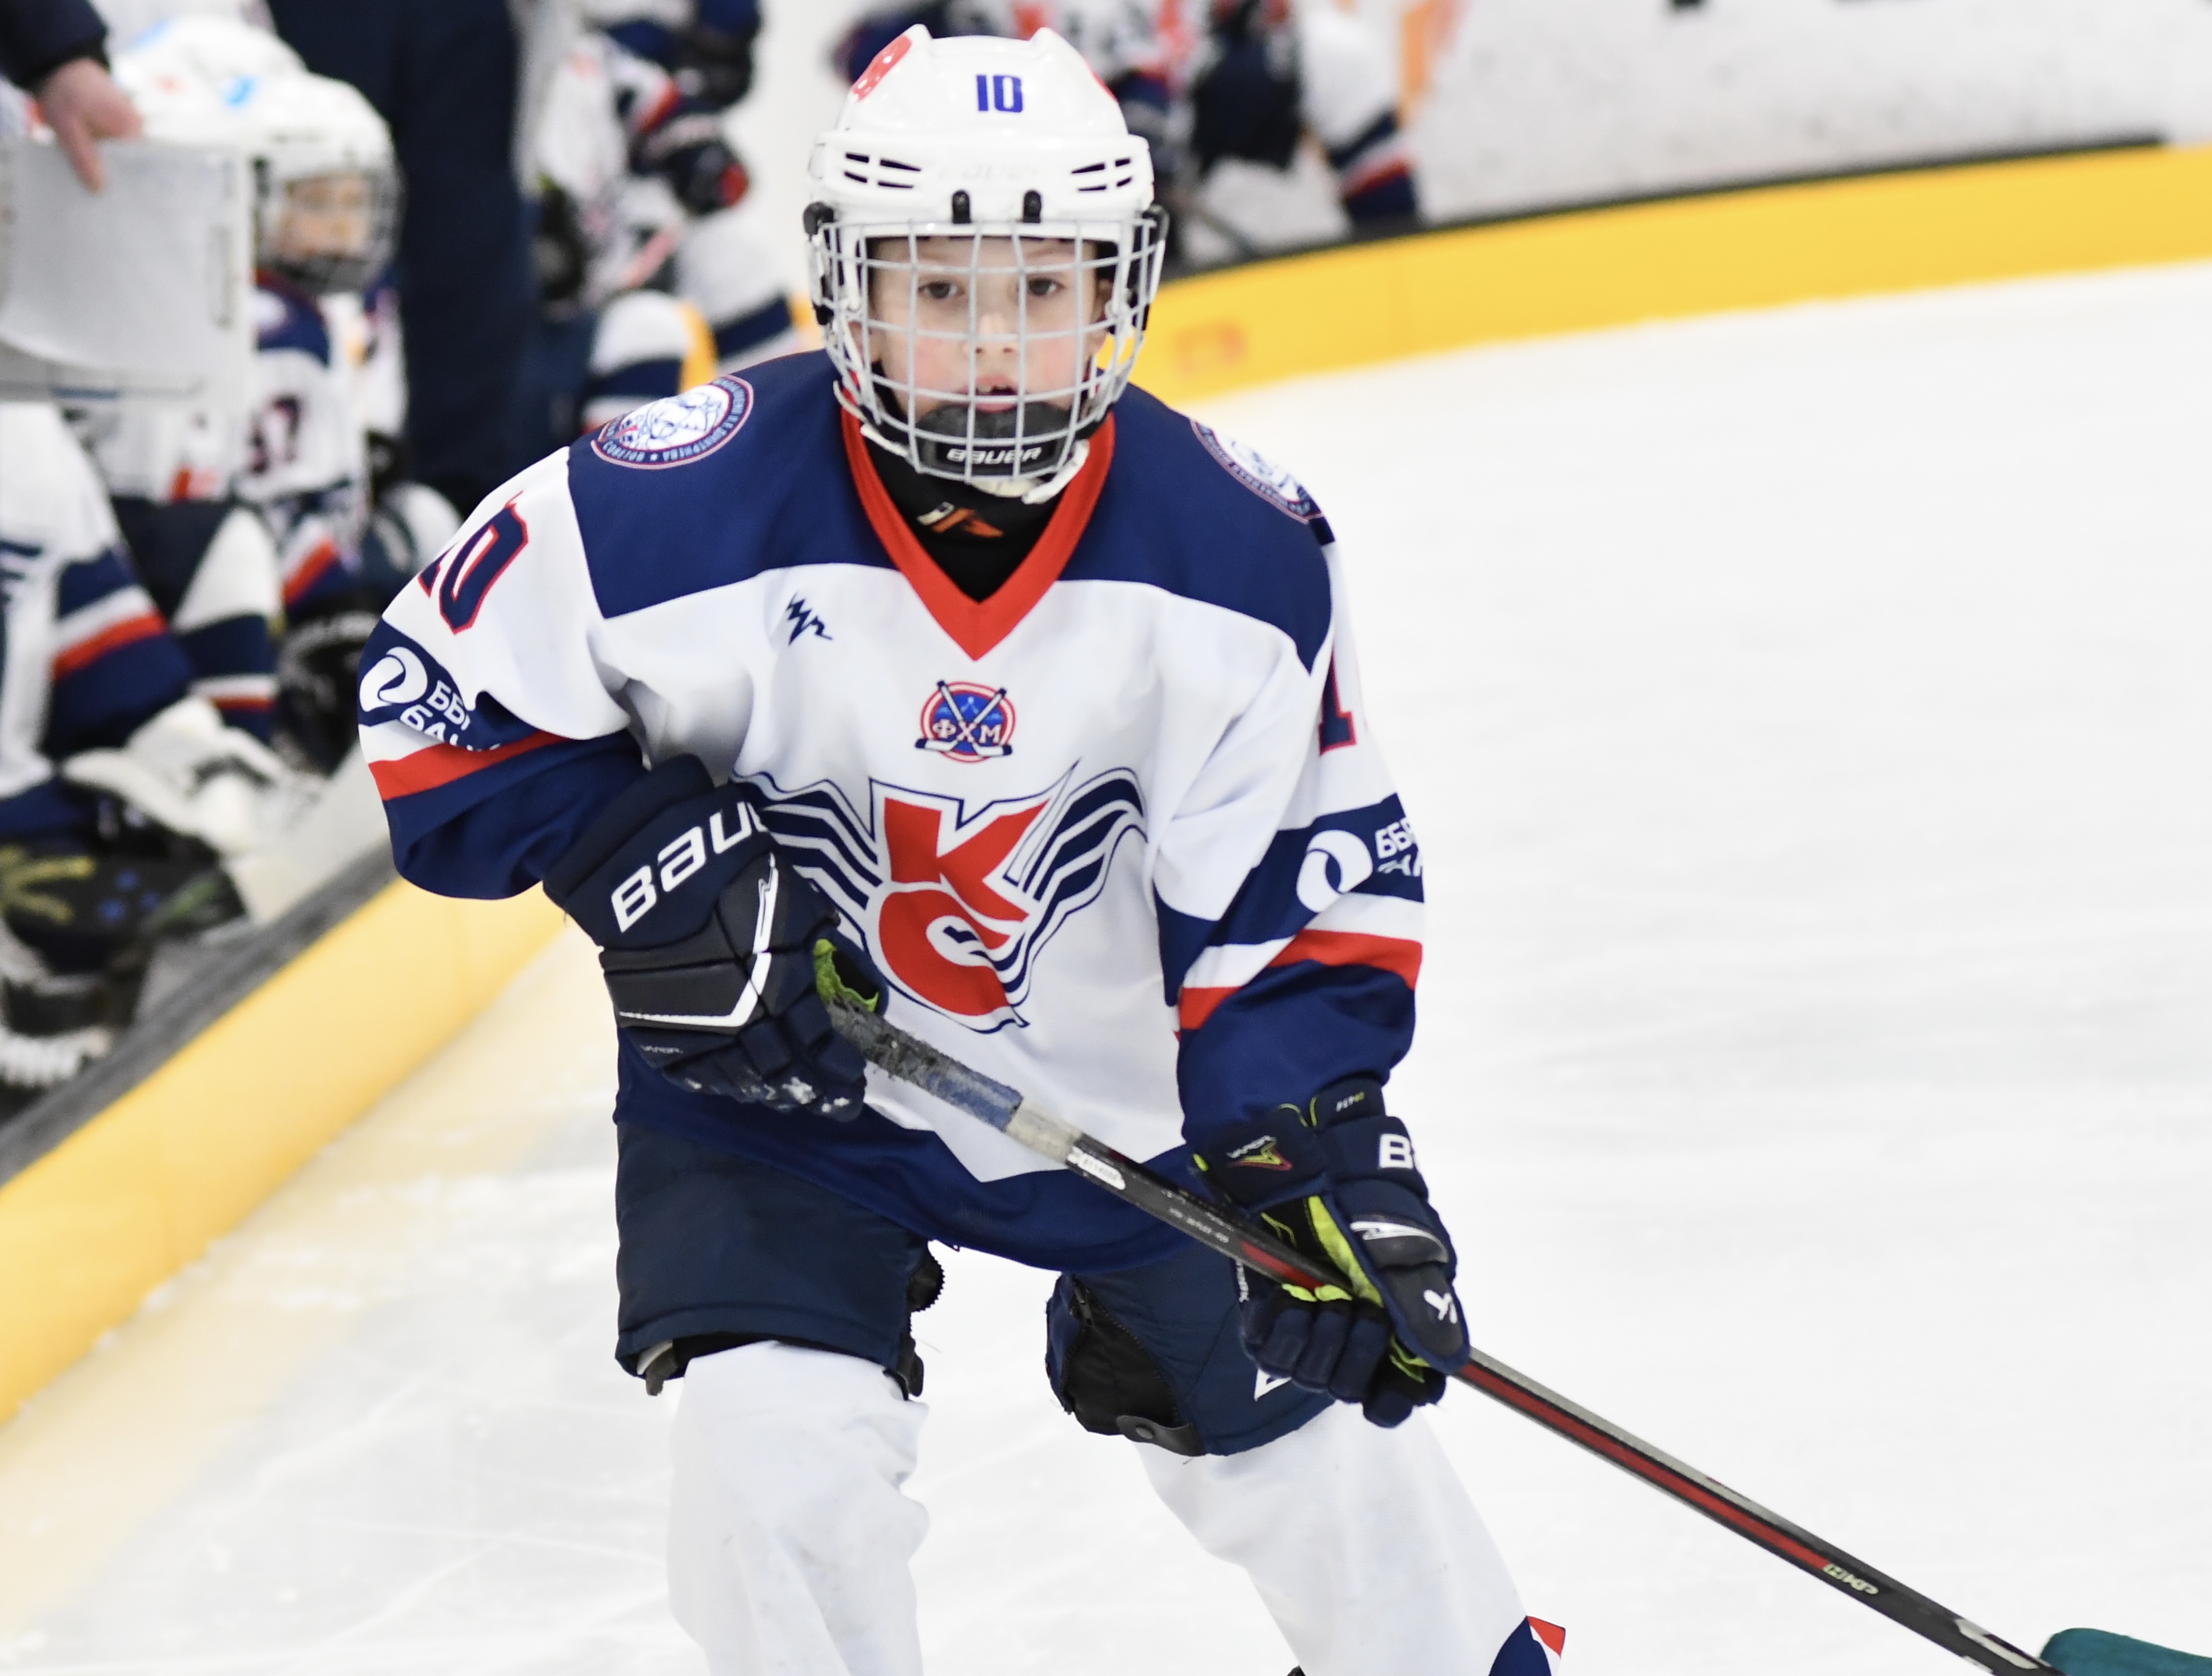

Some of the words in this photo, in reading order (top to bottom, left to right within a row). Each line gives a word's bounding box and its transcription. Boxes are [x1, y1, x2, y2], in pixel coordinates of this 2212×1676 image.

[976, 74, 1023, 113] 10
[1319, 645, 1358, 757] 1
[400, 704, 501, 752] БА
[932, 718, 1002, 743] ФХМ
